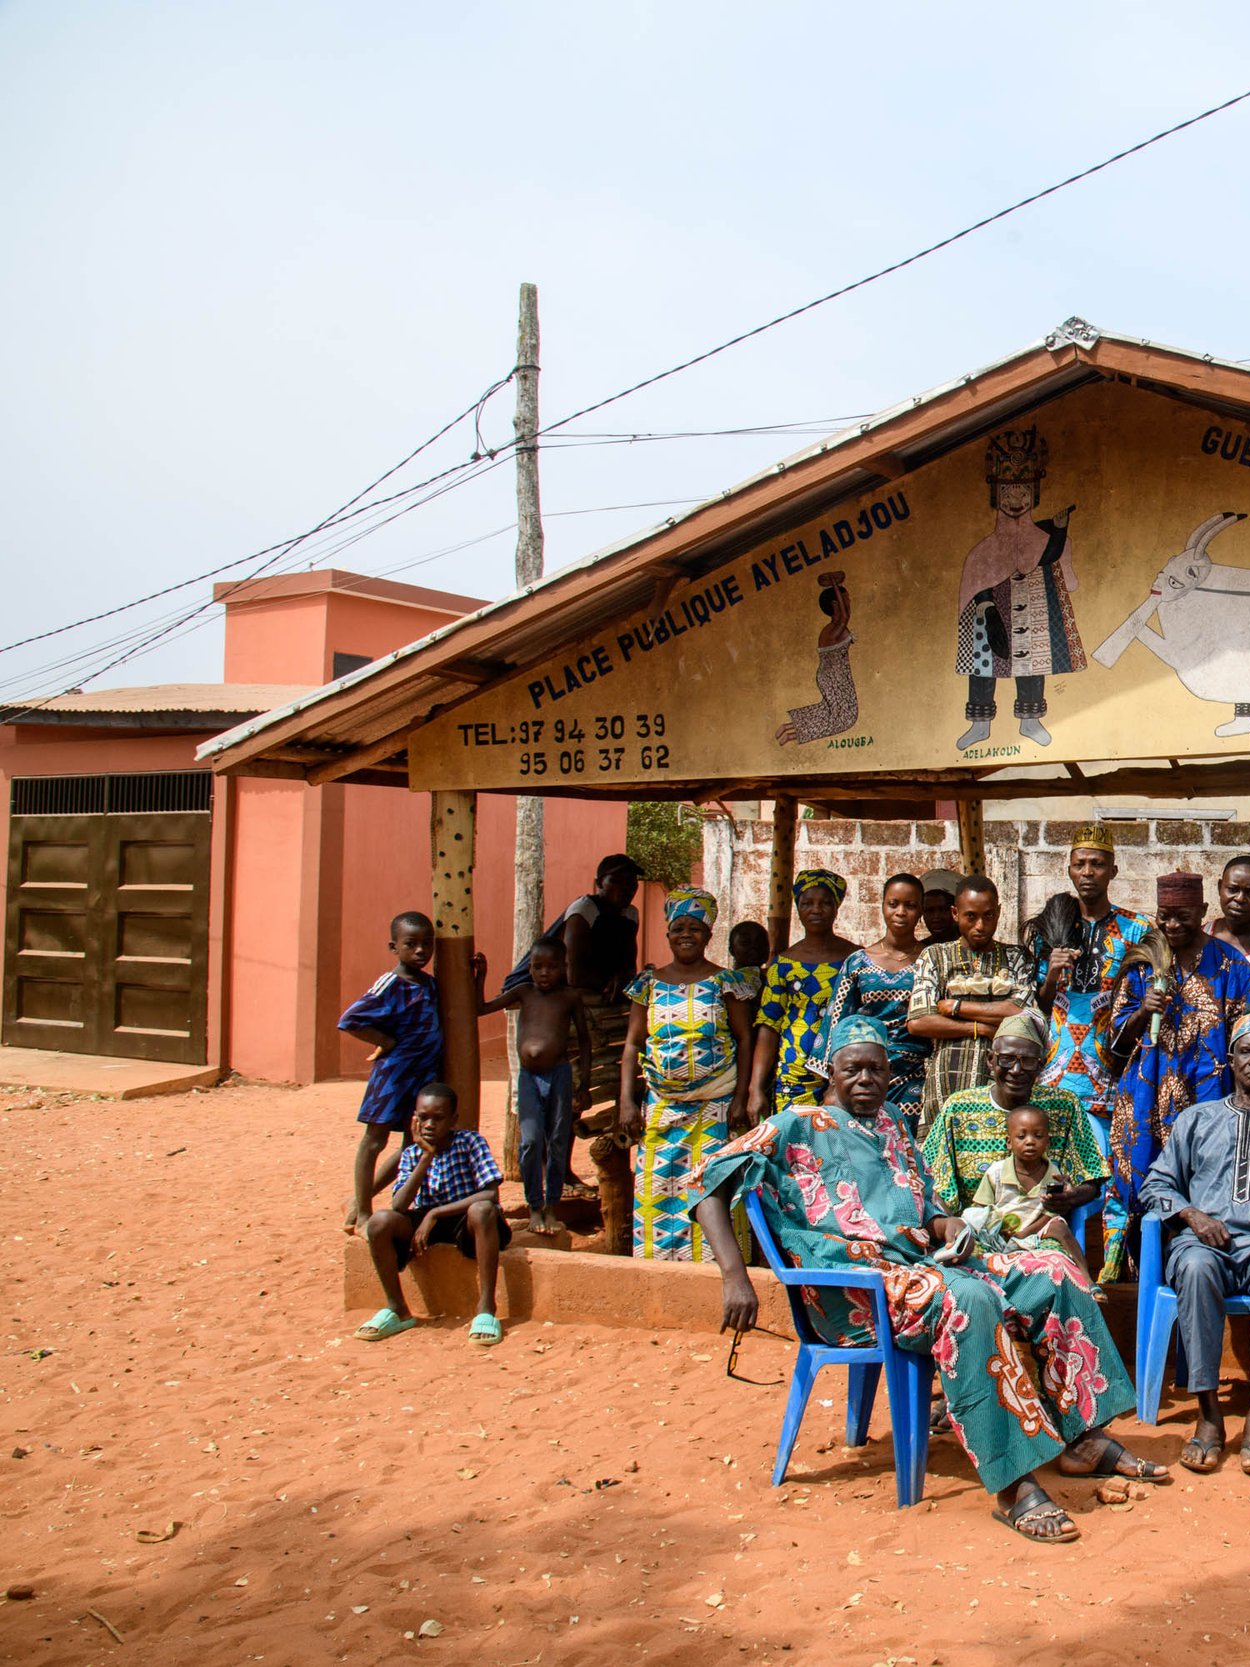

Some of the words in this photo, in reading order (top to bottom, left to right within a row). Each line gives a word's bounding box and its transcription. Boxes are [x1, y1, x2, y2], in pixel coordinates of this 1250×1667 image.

[528, 647, 614, 709] PLACE
[617, 576, 744, 662] PUBLIQUE
[751, 492, 911, 591] AYELADJOU
[554, 718, 586, 743] 94
[595, 715, 625, 740] 30
[636, 714, 665, 738] 39
[520, 752, 547, 775] 95
[559, 749, 585, 774] 06
[598, 747, 625, 771] 37
[641, 745, 669, 769] 62
